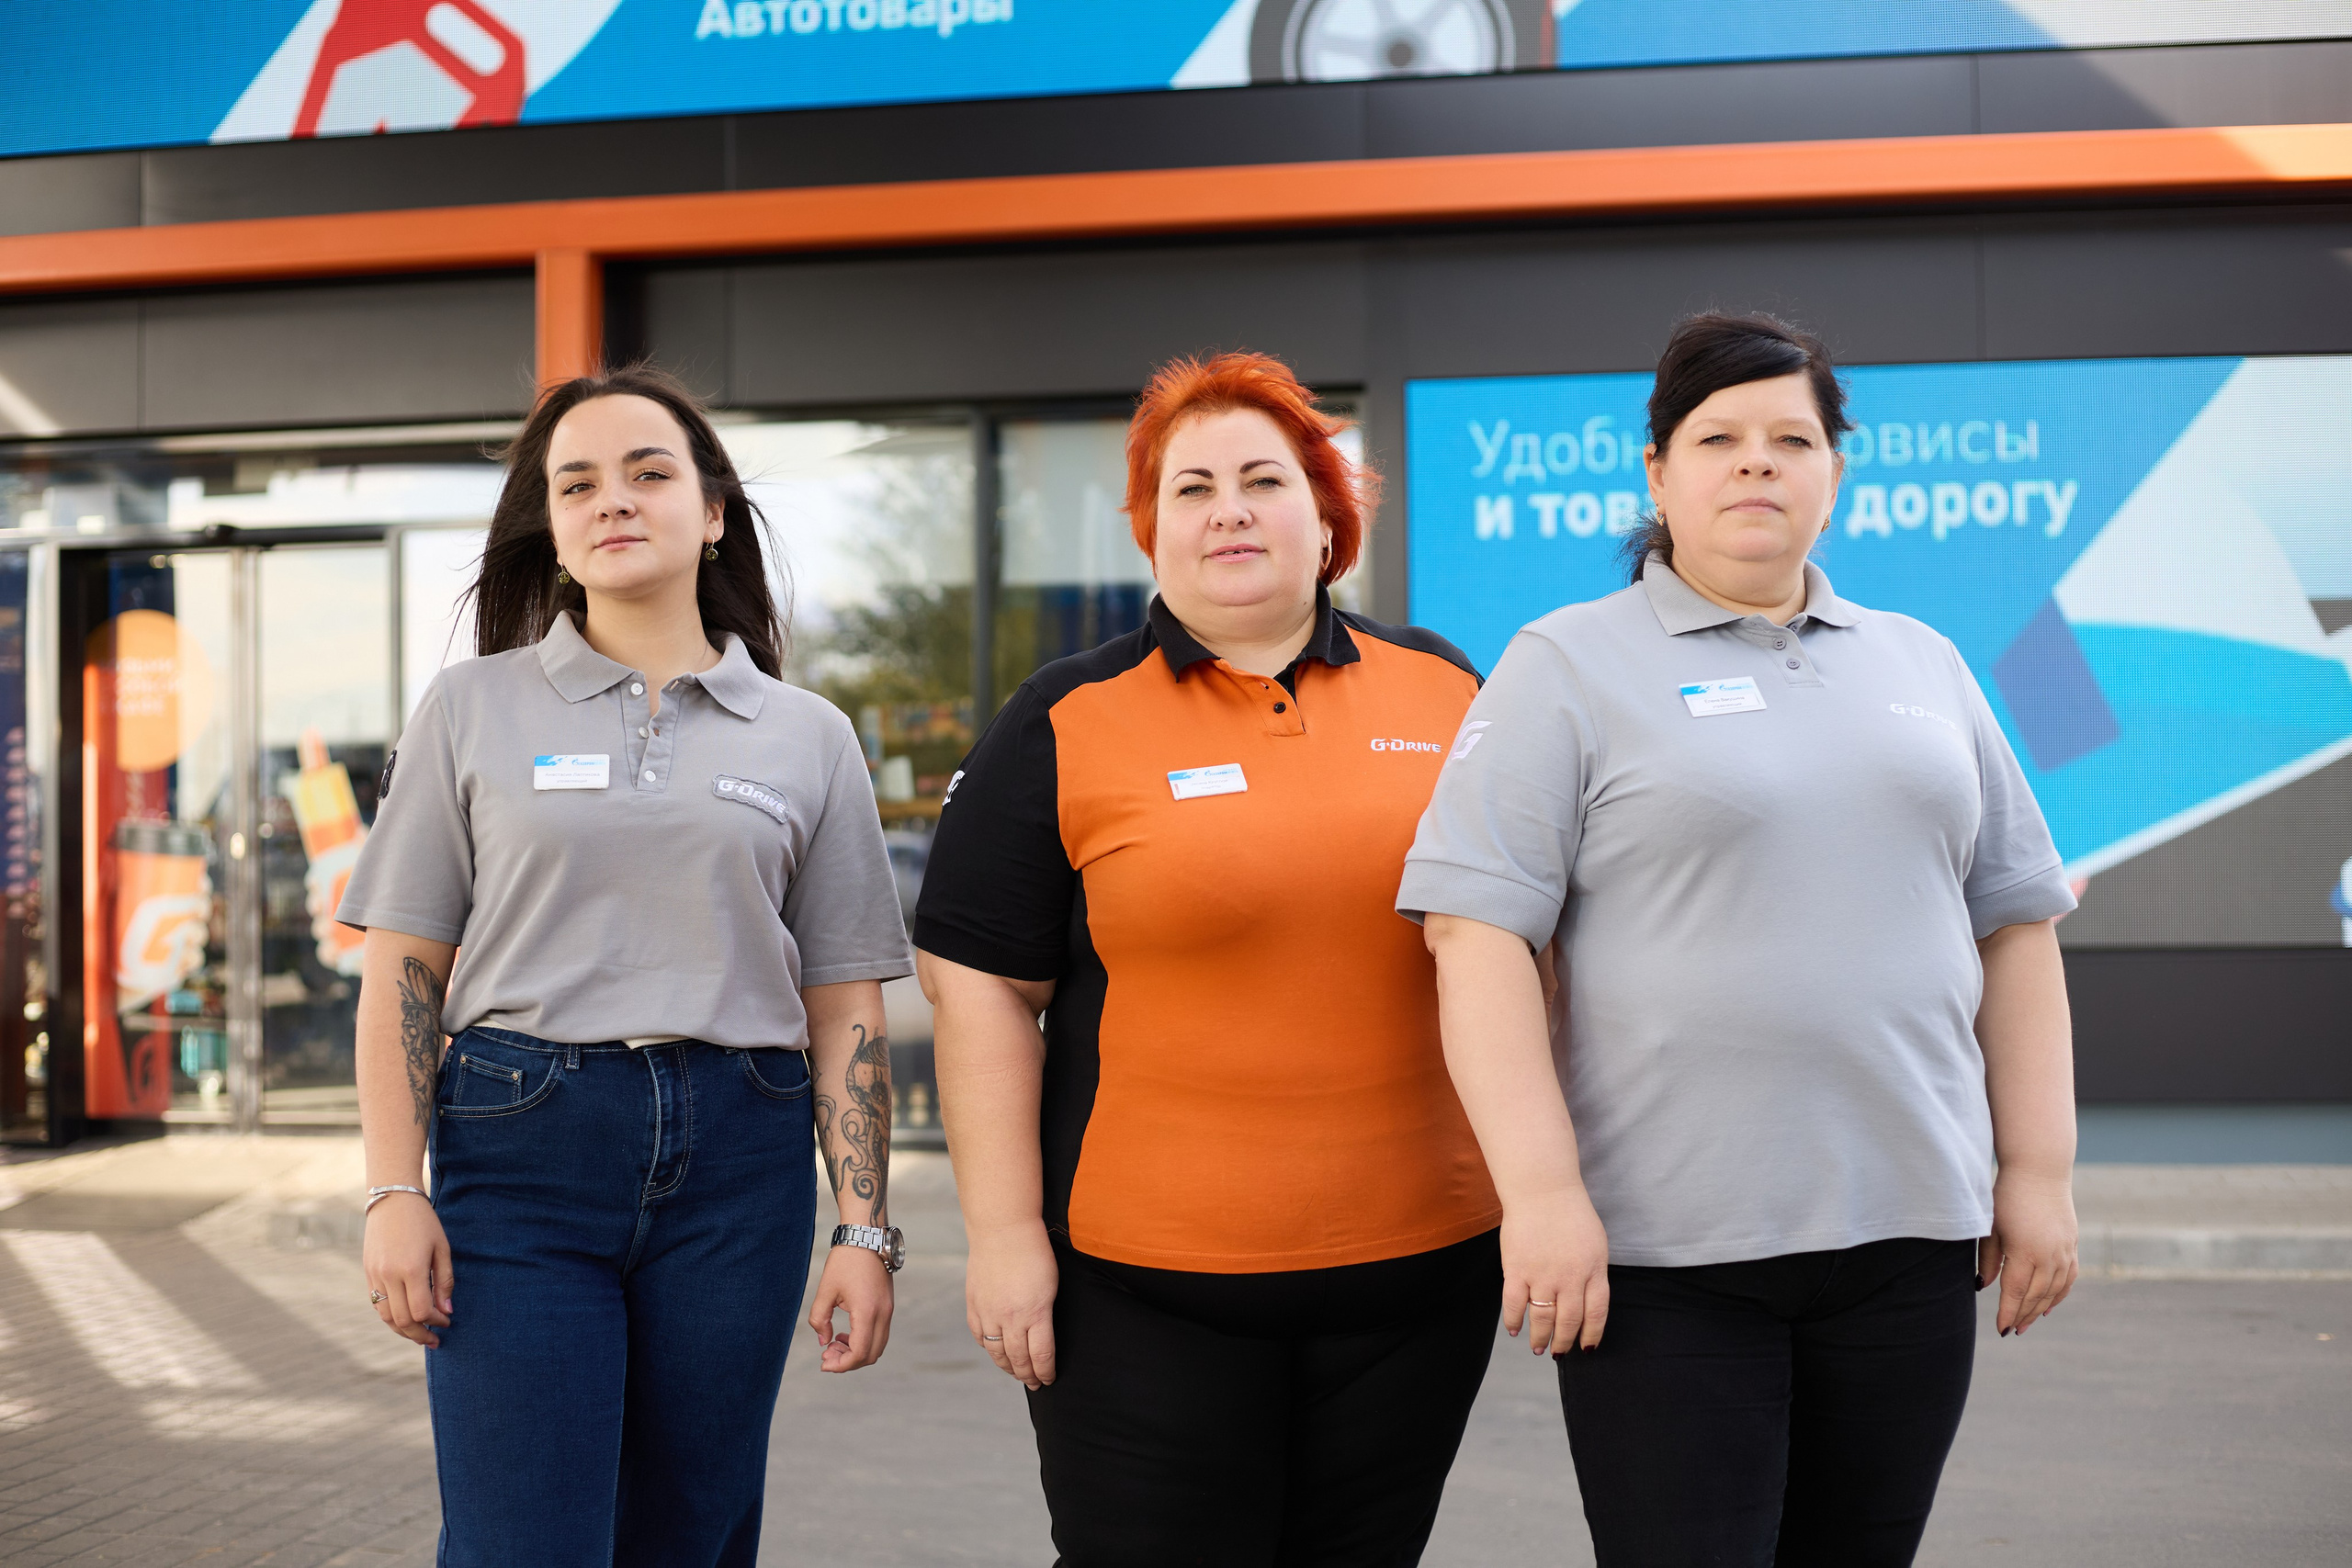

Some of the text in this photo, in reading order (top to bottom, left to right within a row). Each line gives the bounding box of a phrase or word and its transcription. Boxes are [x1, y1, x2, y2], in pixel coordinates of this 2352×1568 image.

[695, 0, 1014, 40] Автотовары
[1469, 414, 2040, 485] Удобн рвисы
[1475, 477, 2079, 540] и тов дорогу
